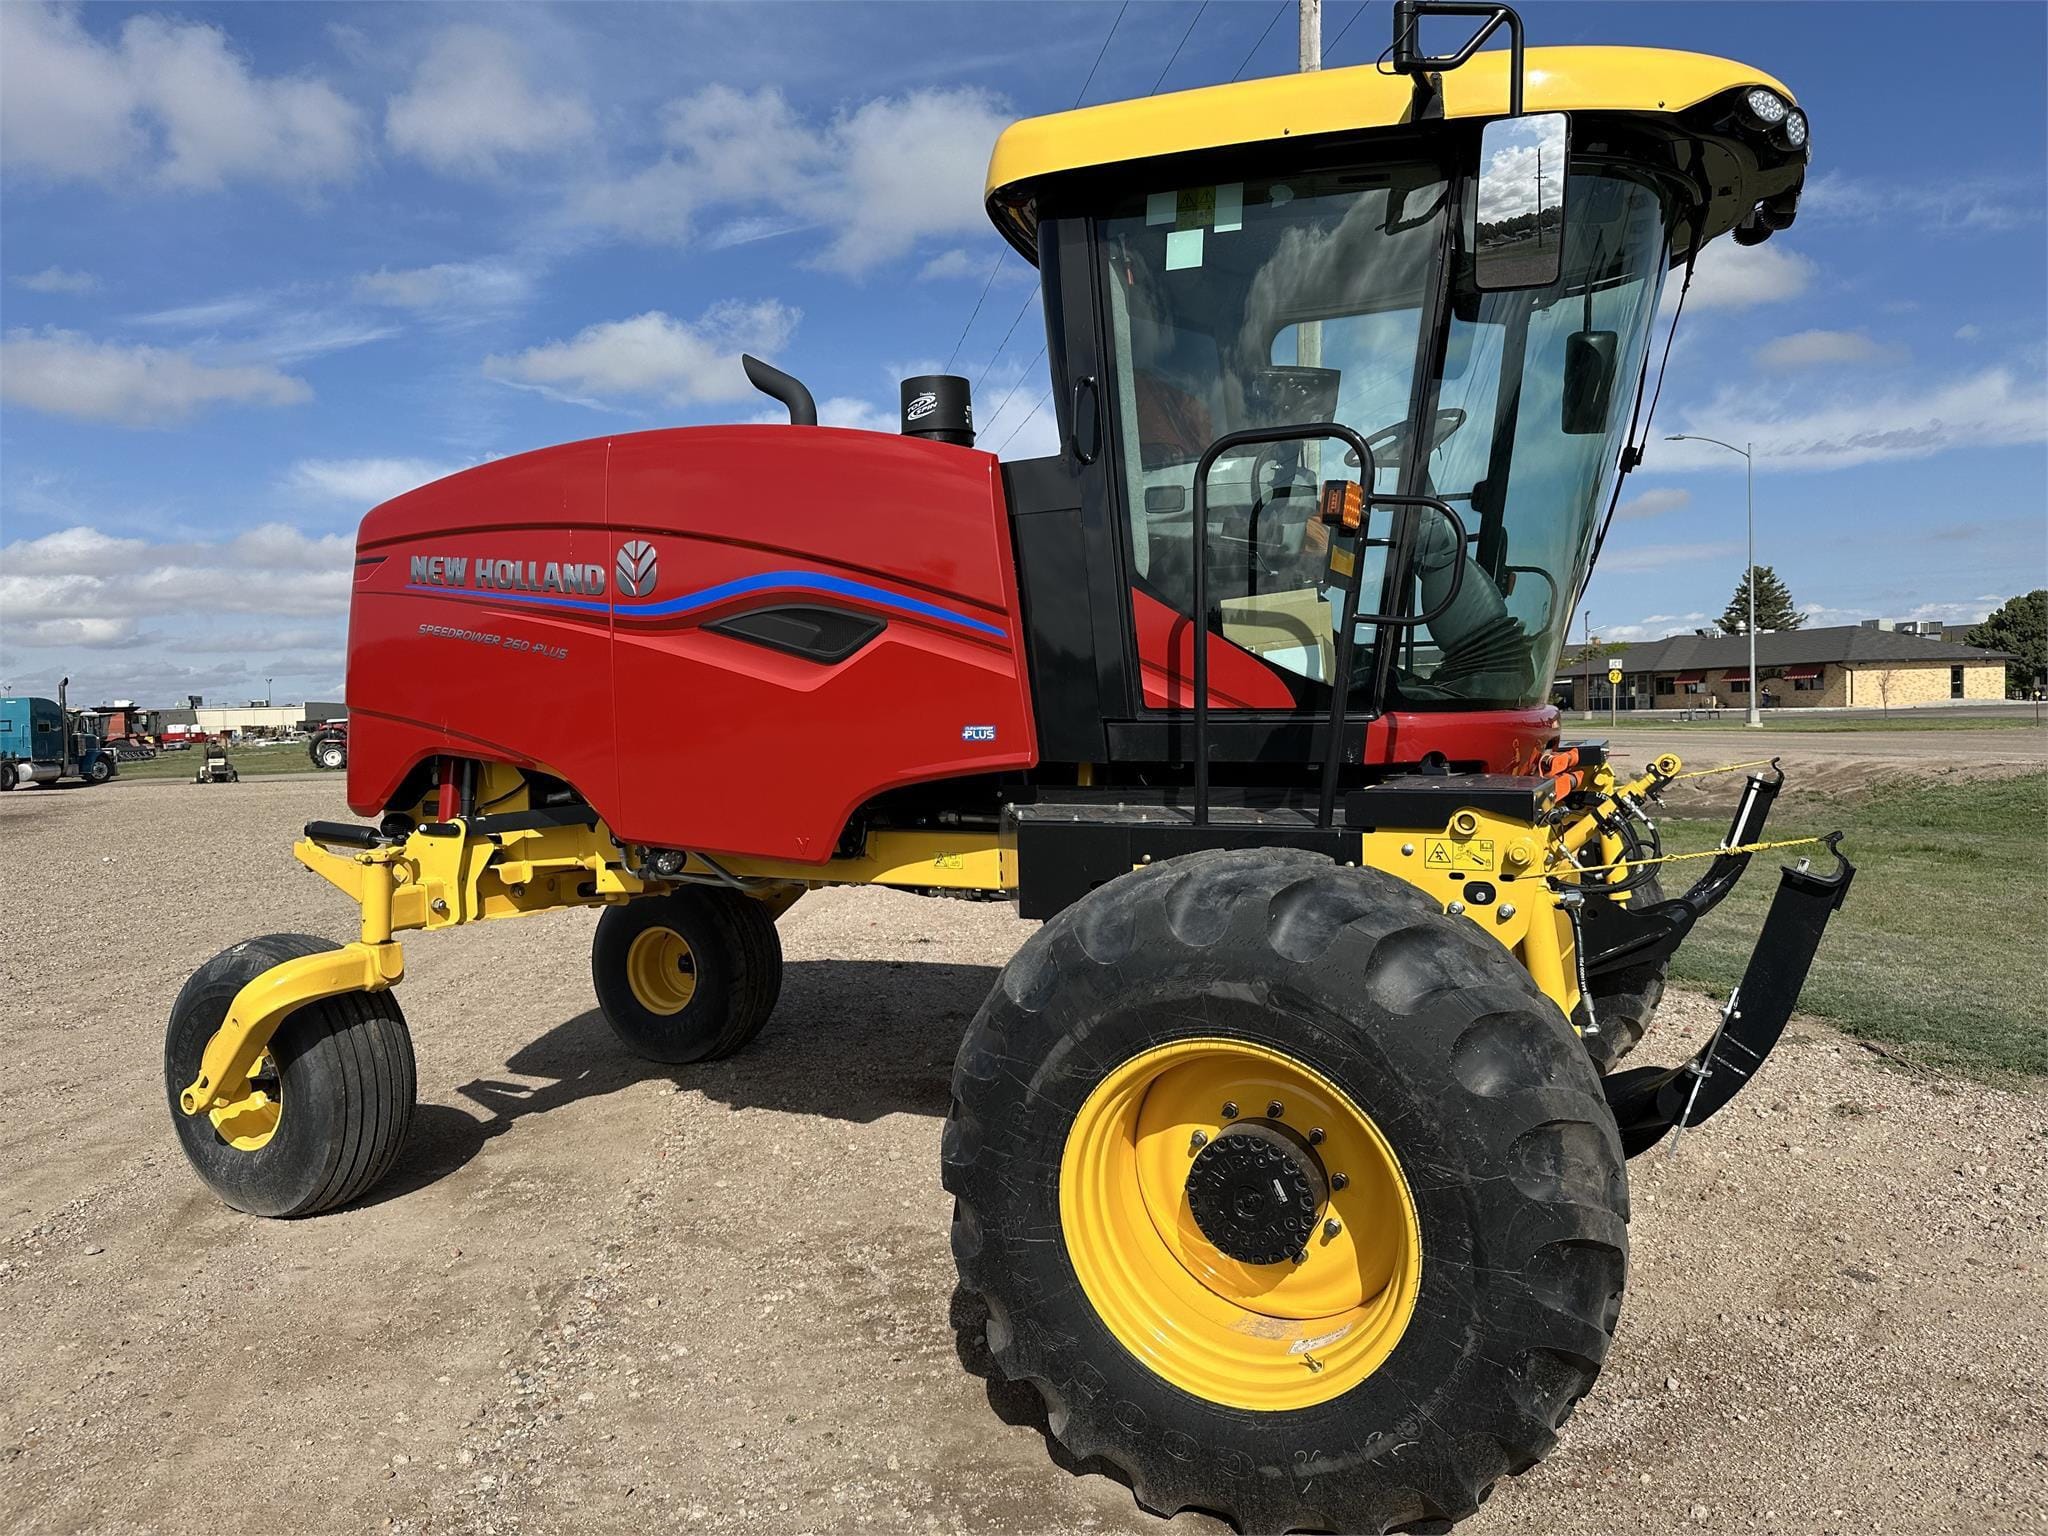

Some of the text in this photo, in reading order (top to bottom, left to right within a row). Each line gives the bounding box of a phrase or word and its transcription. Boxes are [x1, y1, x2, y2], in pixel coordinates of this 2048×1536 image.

[410, 555, 606, 596] NEW HOLLAND
[418, 623, 501, 646] SPEEDROWER
[502, 637, 530, 652] 260
[1610, 672, 1620, 680] 27
